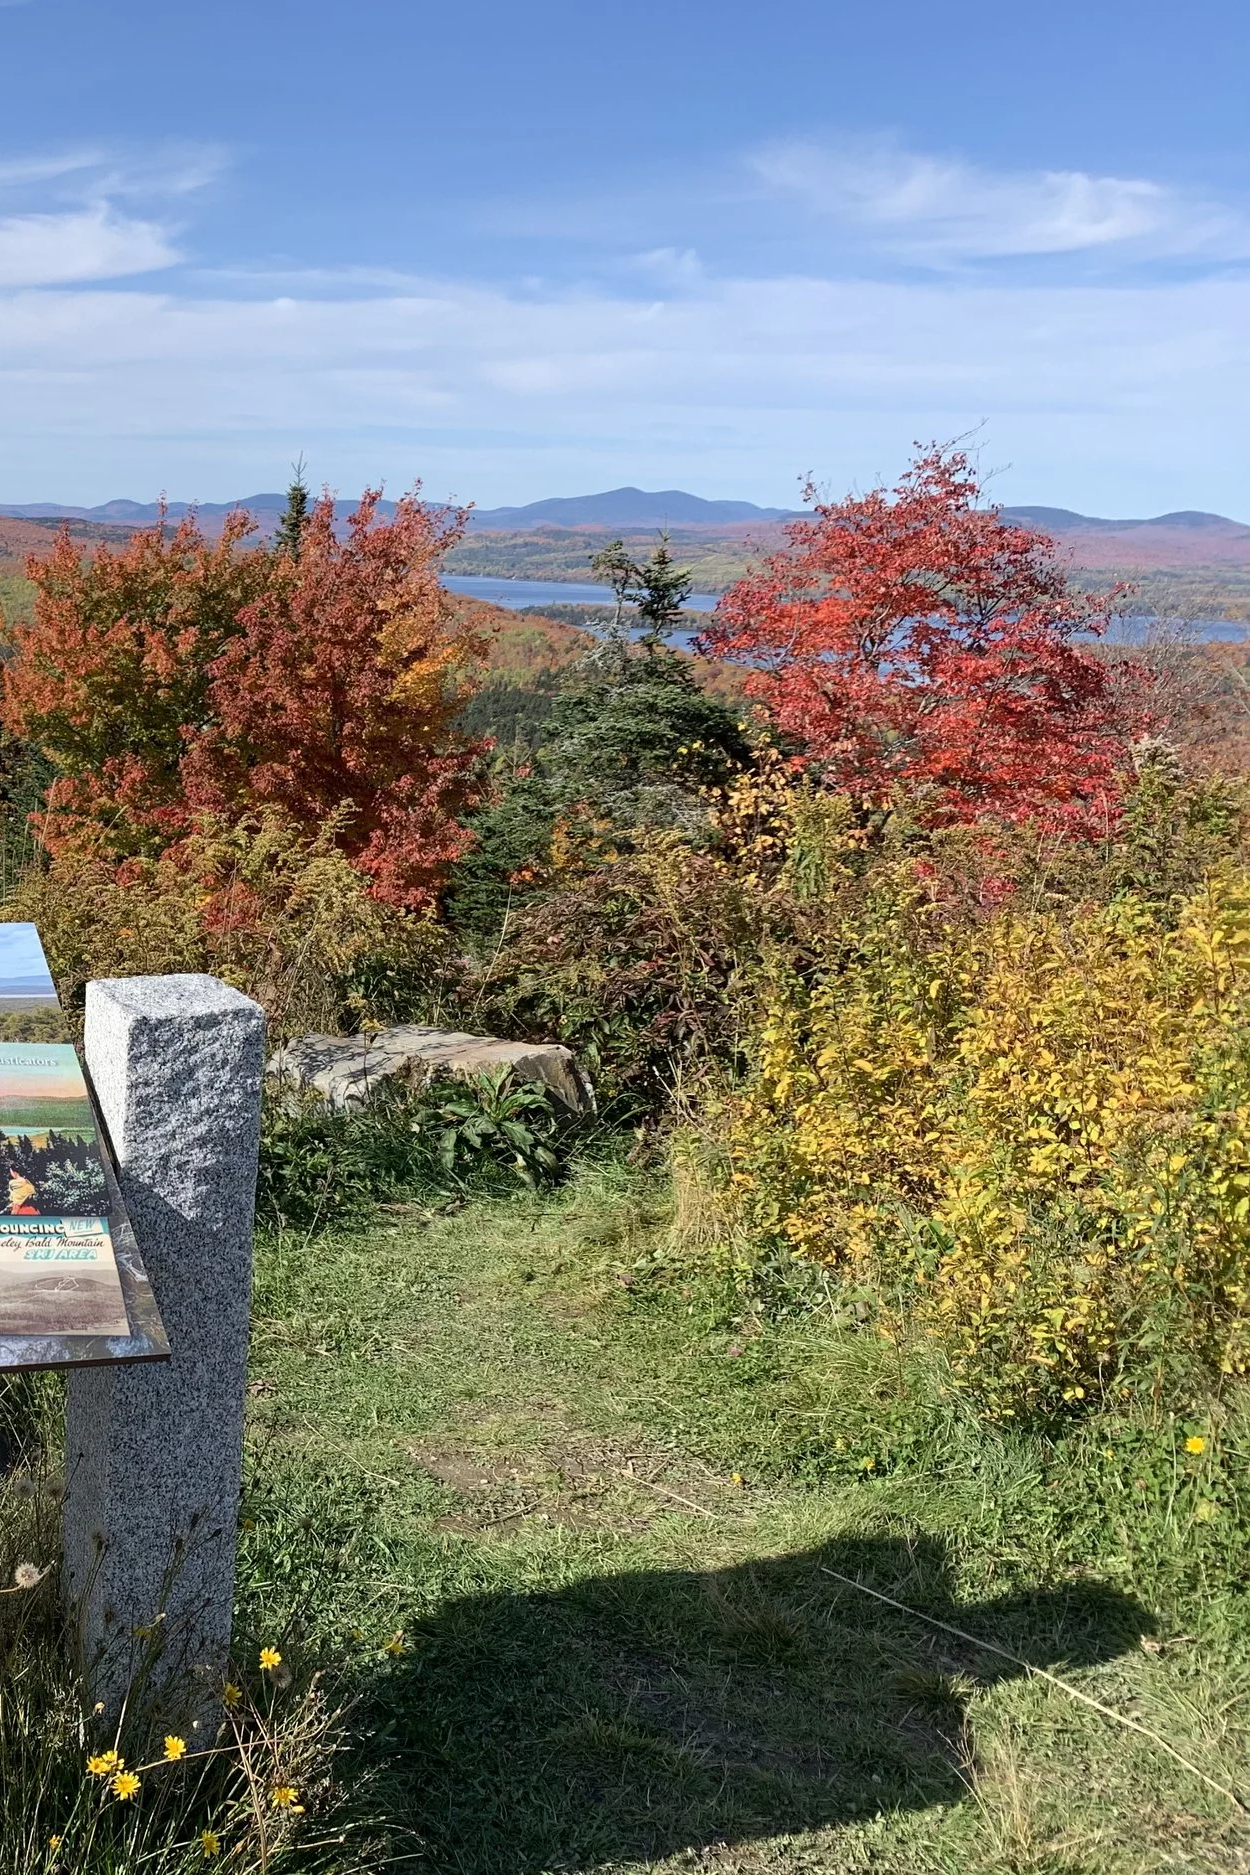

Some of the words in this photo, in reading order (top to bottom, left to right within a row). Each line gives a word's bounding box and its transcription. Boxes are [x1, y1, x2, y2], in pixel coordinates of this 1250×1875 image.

[70, 1220, 95, 1230] NEW
[25, 1237, 50, 1247] Bald
[56, 1237, 104, 1247] Mountain
[24, 1250, 54, 1259] SKI
[55, 1250, 97, 1259] AREA
